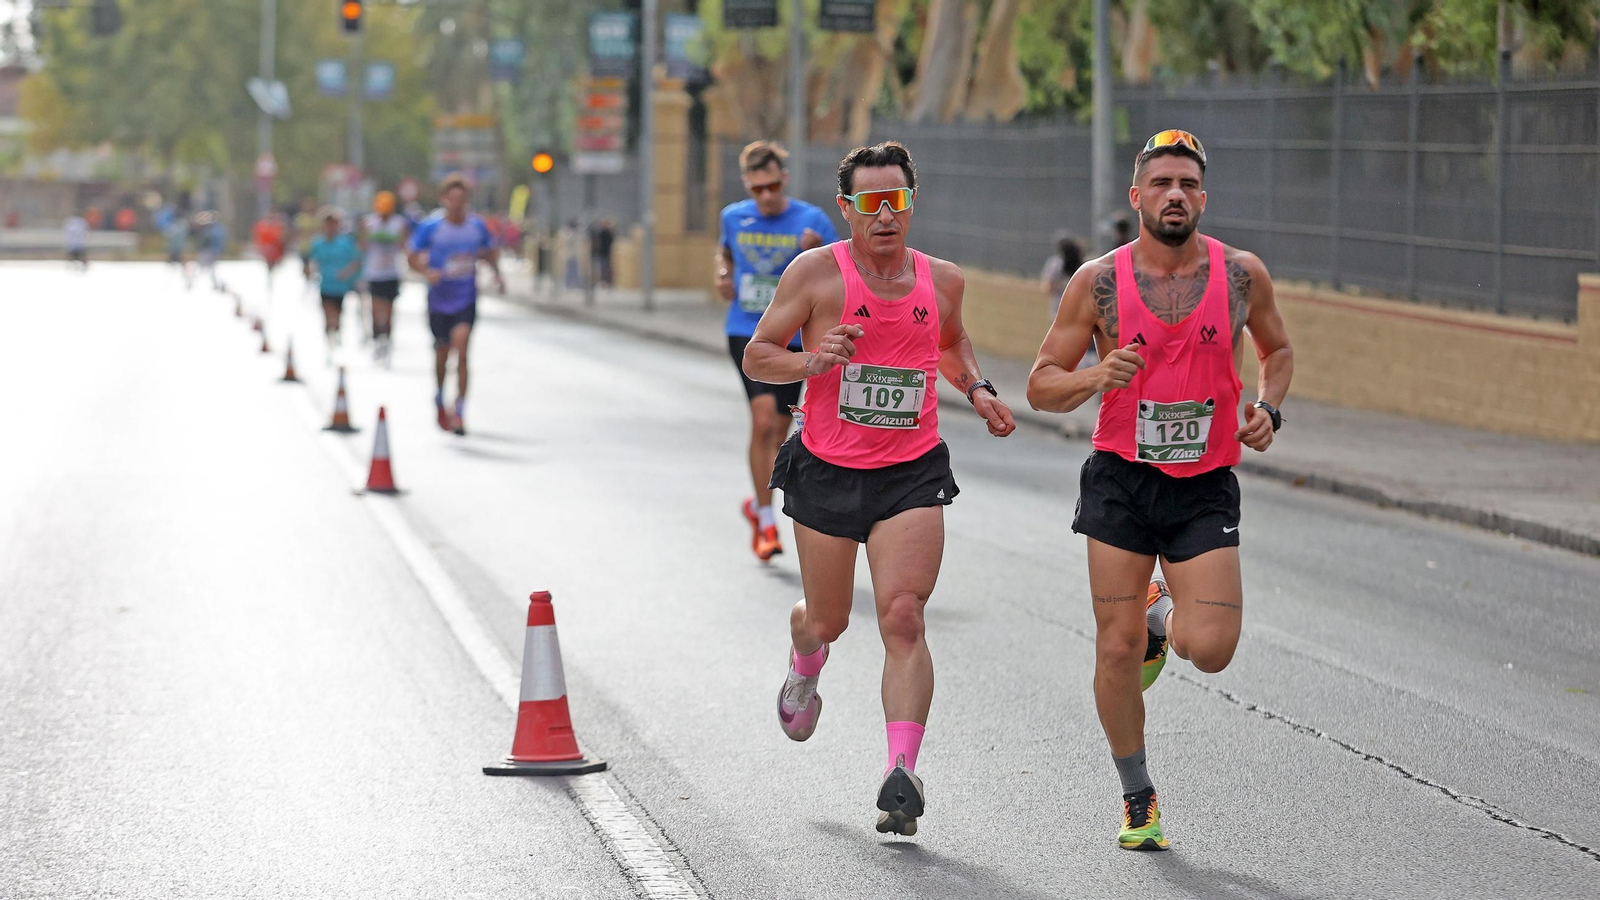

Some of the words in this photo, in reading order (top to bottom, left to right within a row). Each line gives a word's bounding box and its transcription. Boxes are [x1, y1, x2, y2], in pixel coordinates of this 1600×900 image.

[862, 386, 905, 409] 109
[869, 414, 914, 426] MIZUNO
[1156, 421, 1200, 443] 120
